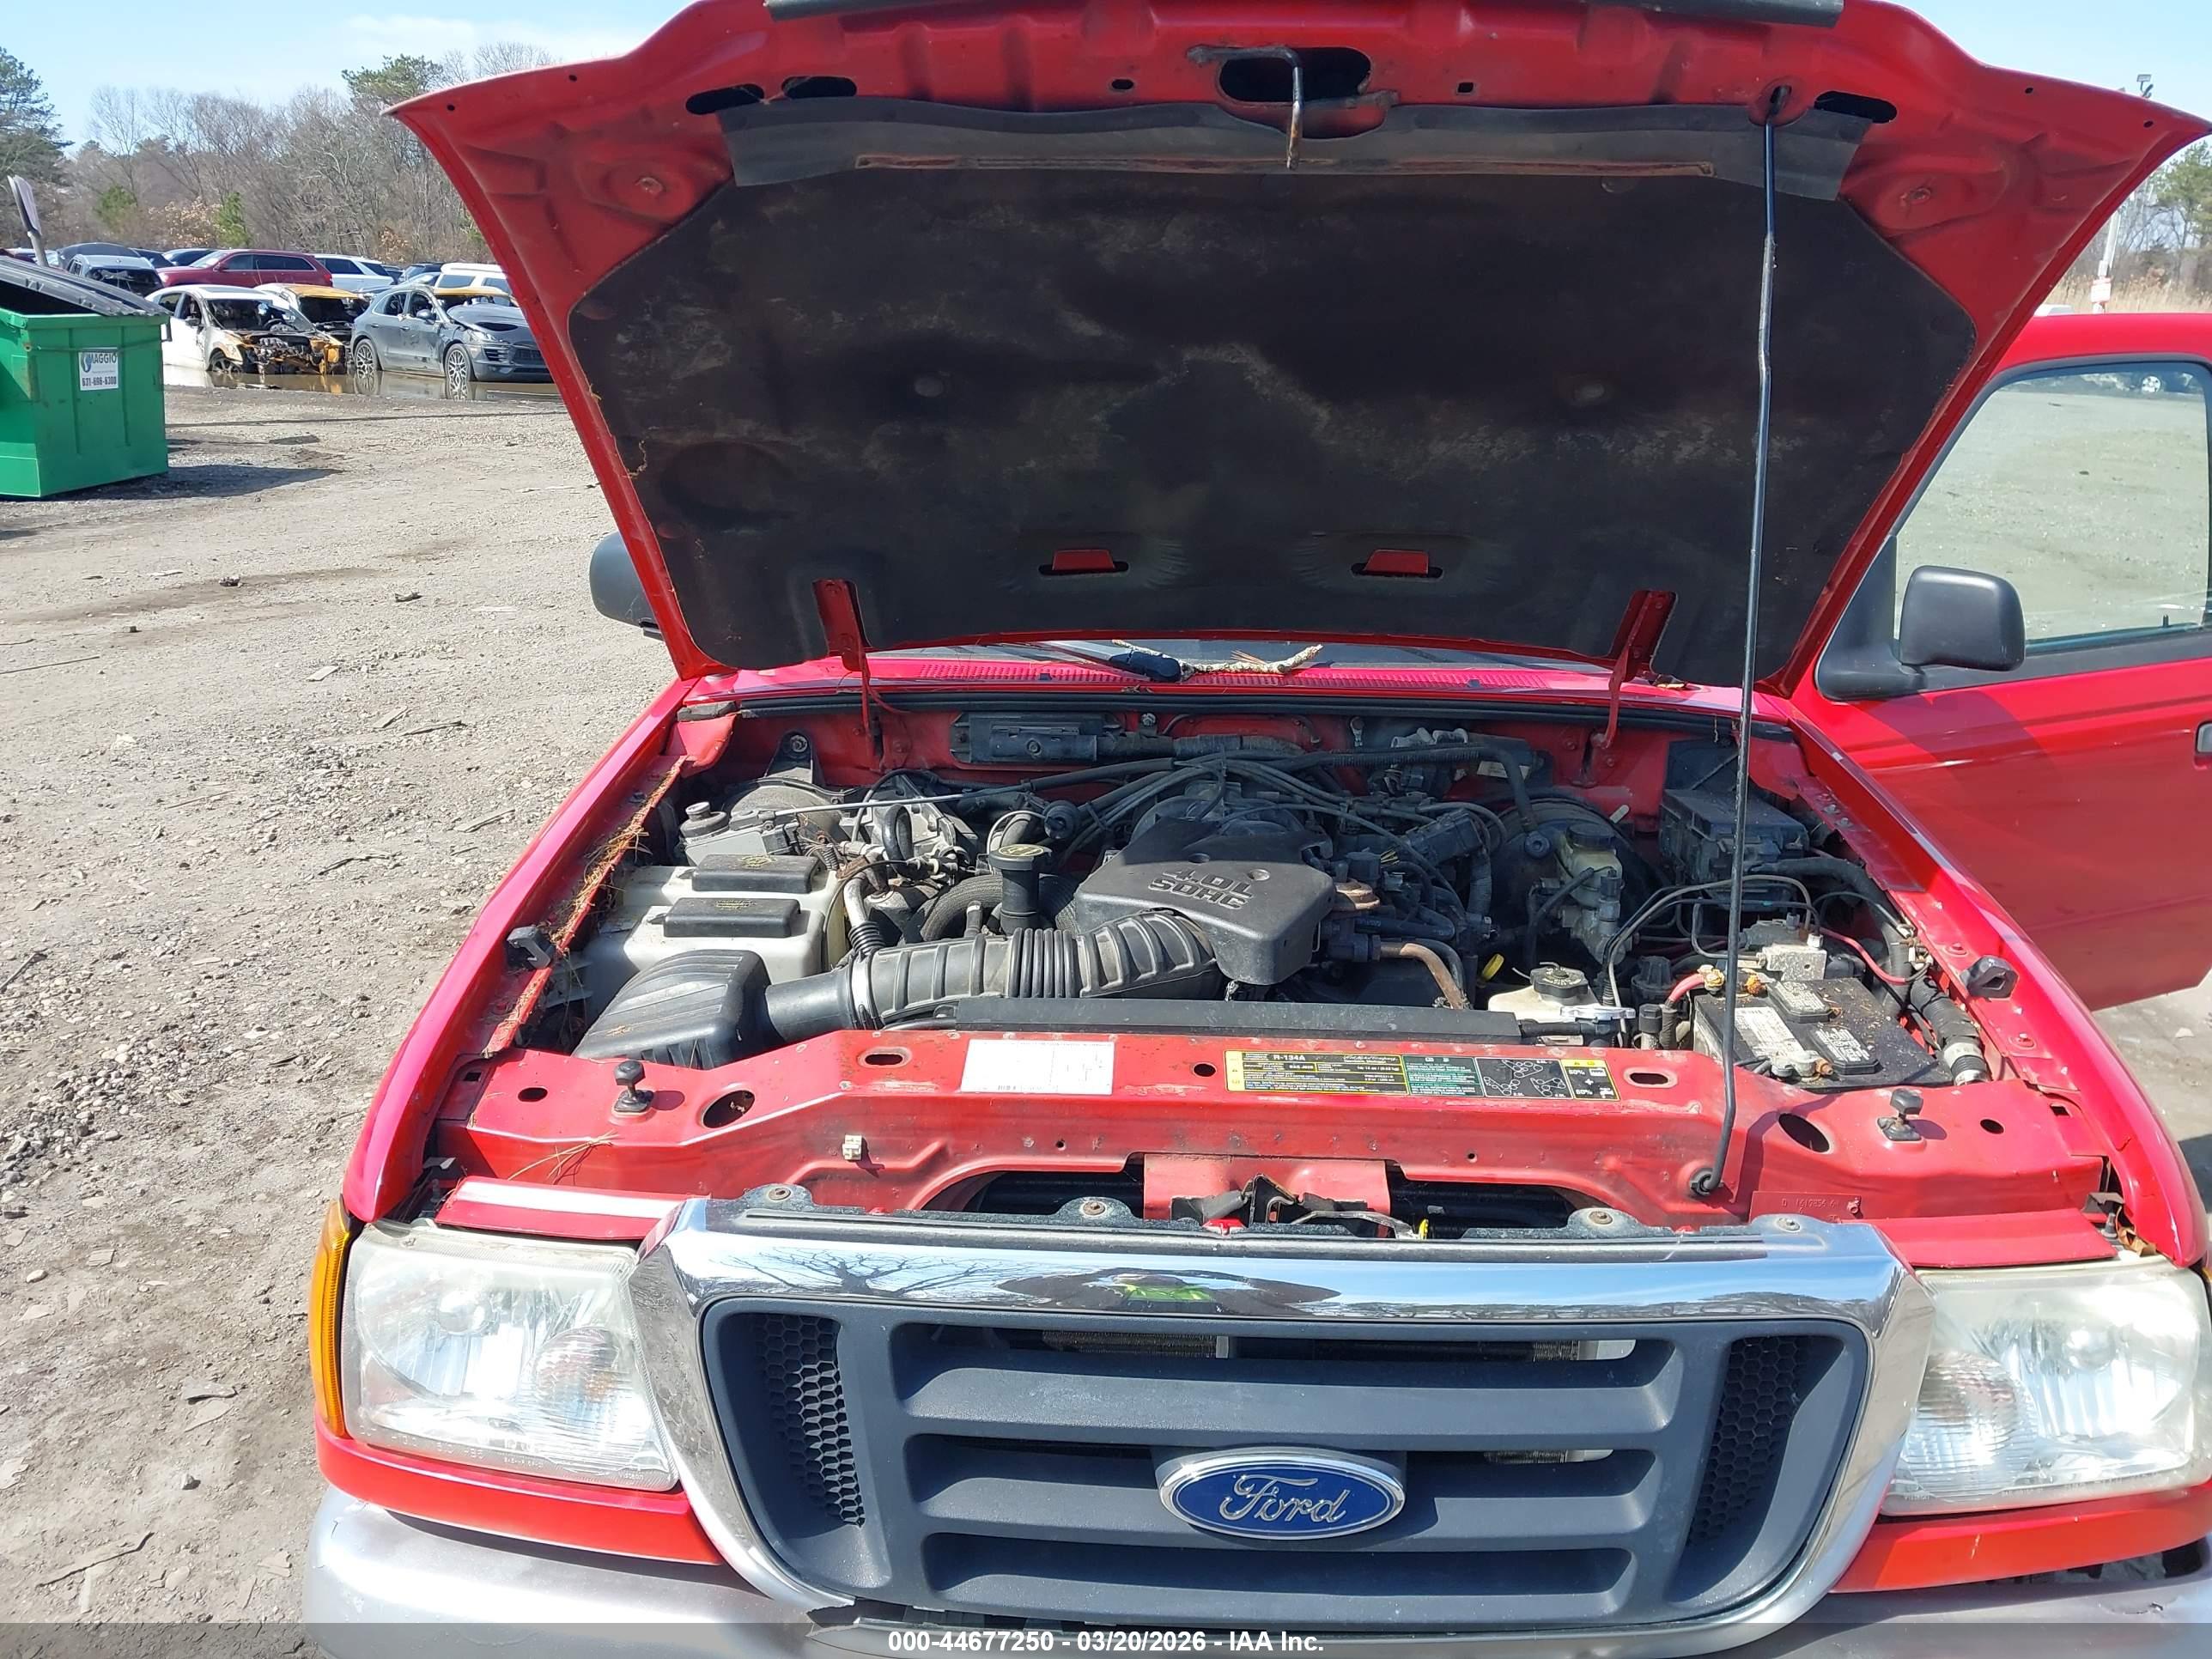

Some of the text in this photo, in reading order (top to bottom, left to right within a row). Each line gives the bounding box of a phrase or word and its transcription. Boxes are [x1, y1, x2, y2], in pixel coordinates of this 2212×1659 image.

[1147, 877, 1249, 910] SOHC
[1161, 868, 1254, 898] 4.0L
[1218, 1474, 1351, 1523] Ford
